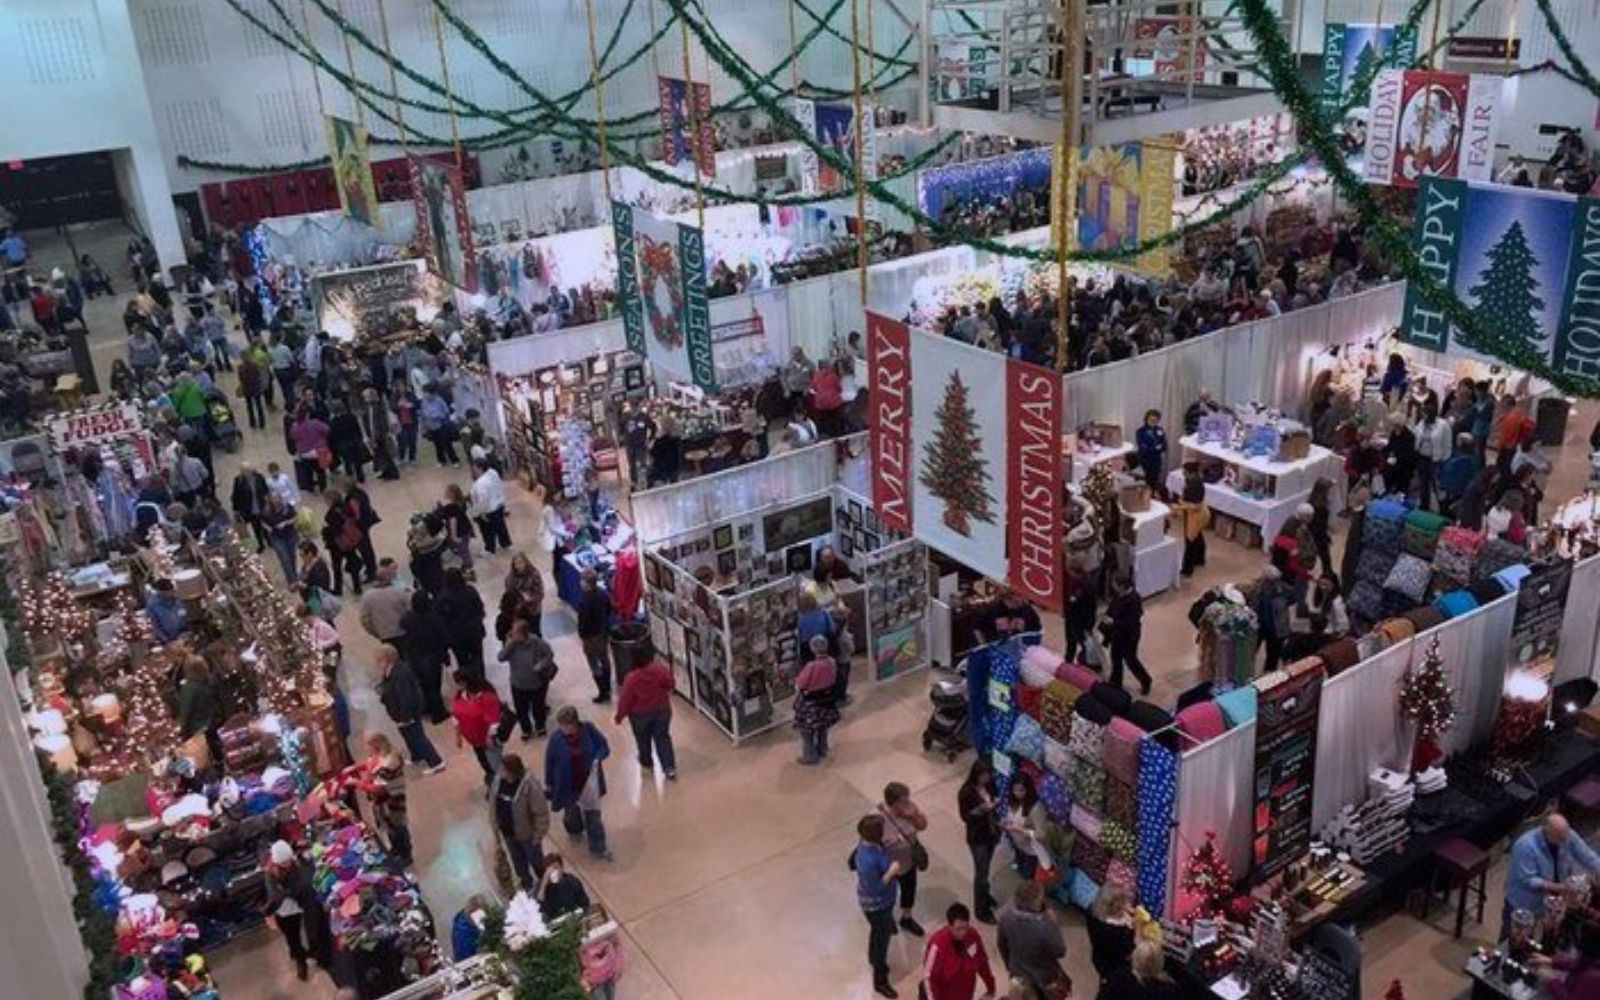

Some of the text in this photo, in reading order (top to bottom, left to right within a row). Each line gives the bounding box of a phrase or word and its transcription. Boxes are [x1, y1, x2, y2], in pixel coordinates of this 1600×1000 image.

[1323, 28, 1346, 107] HAPPY
[1368, 74, 1399, 181] HOLIDAY
[1468, 103, 1493, 168] FAIR
[1143, 151, 1171, 272] CRISTMAS
[1410, 183, 1460, 345] HPPY
[684, 230, 713, 386] GREETINGS
[63, 418, 136, 442] FUDGE
[67, 408, 124, 434] FRESH
[876, 325, 908, 524] MERRY
[1019, 372, 1053, 597] CHRISTMAS
